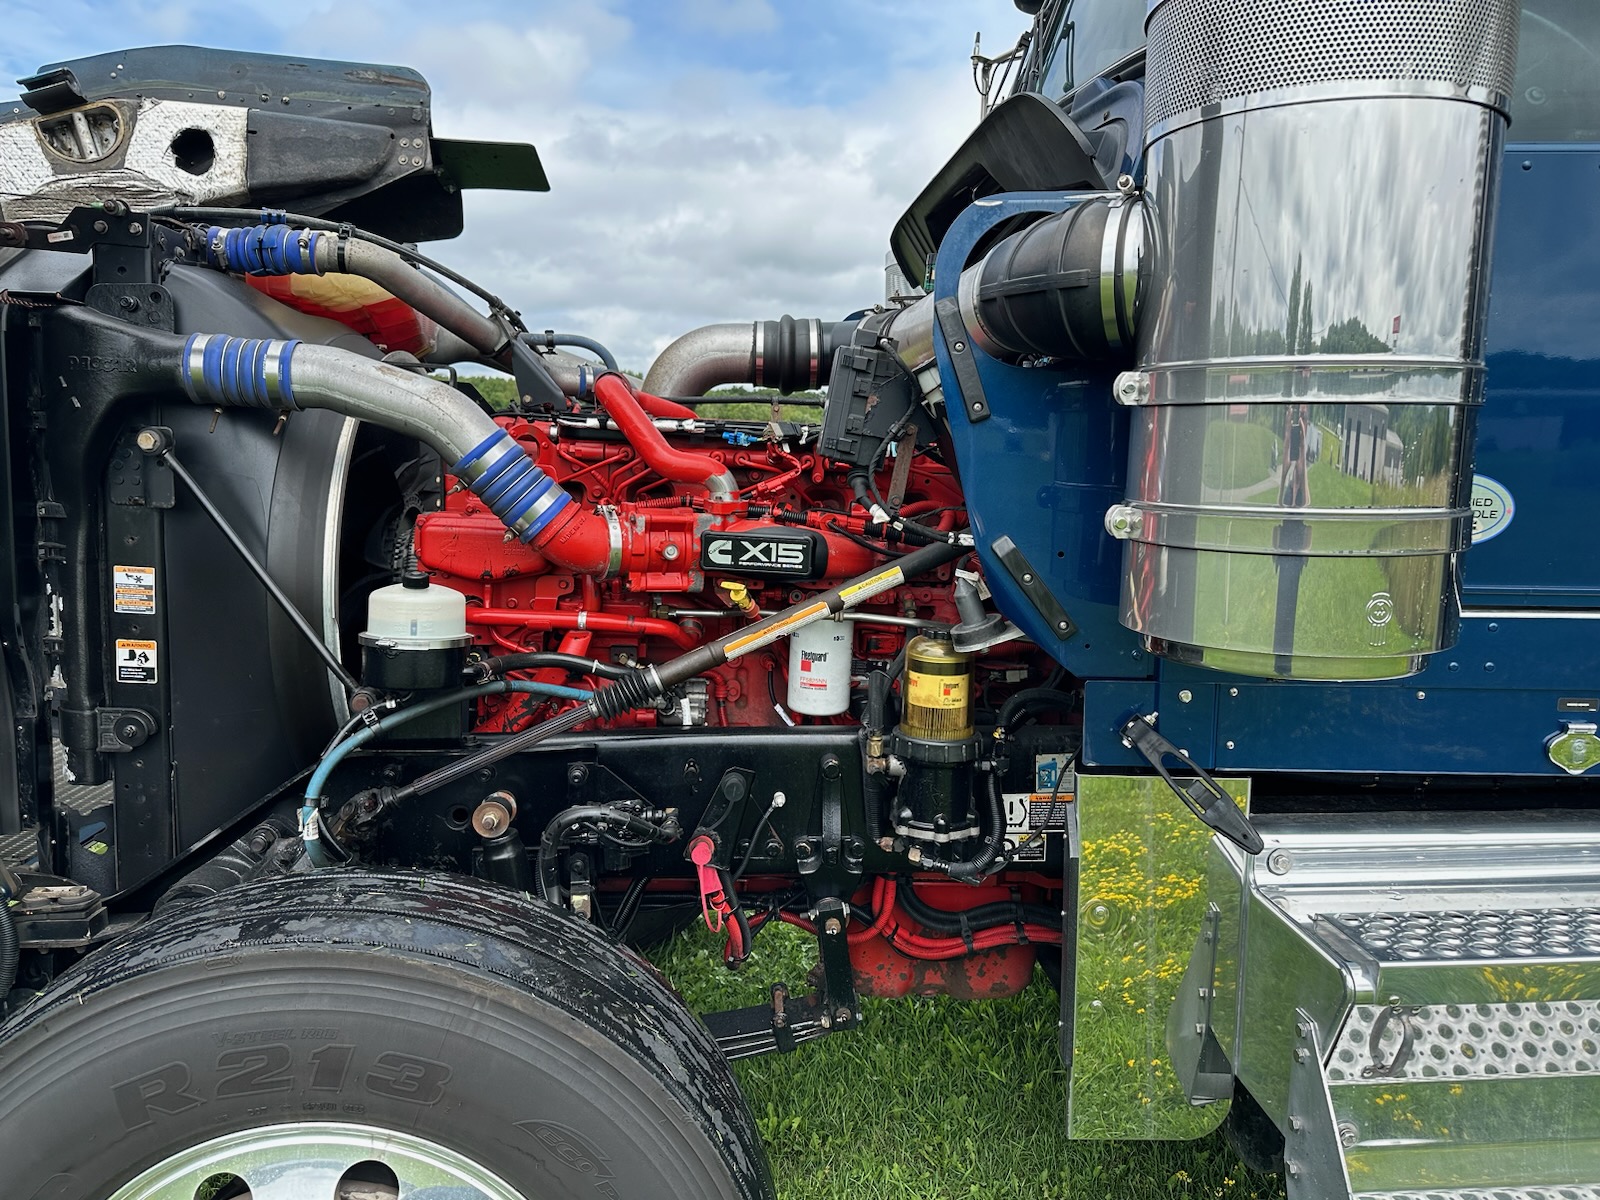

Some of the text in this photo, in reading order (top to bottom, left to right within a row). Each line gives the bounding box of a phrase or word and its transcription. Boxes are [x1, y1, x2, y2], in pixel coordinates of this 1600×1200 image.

[739, 541, 804, 564] X15
[861, 575, 883, 590] CAUTION
[766, 620, 789, 634] WARNING
[801, 650, 827, 663] Fleetguard
